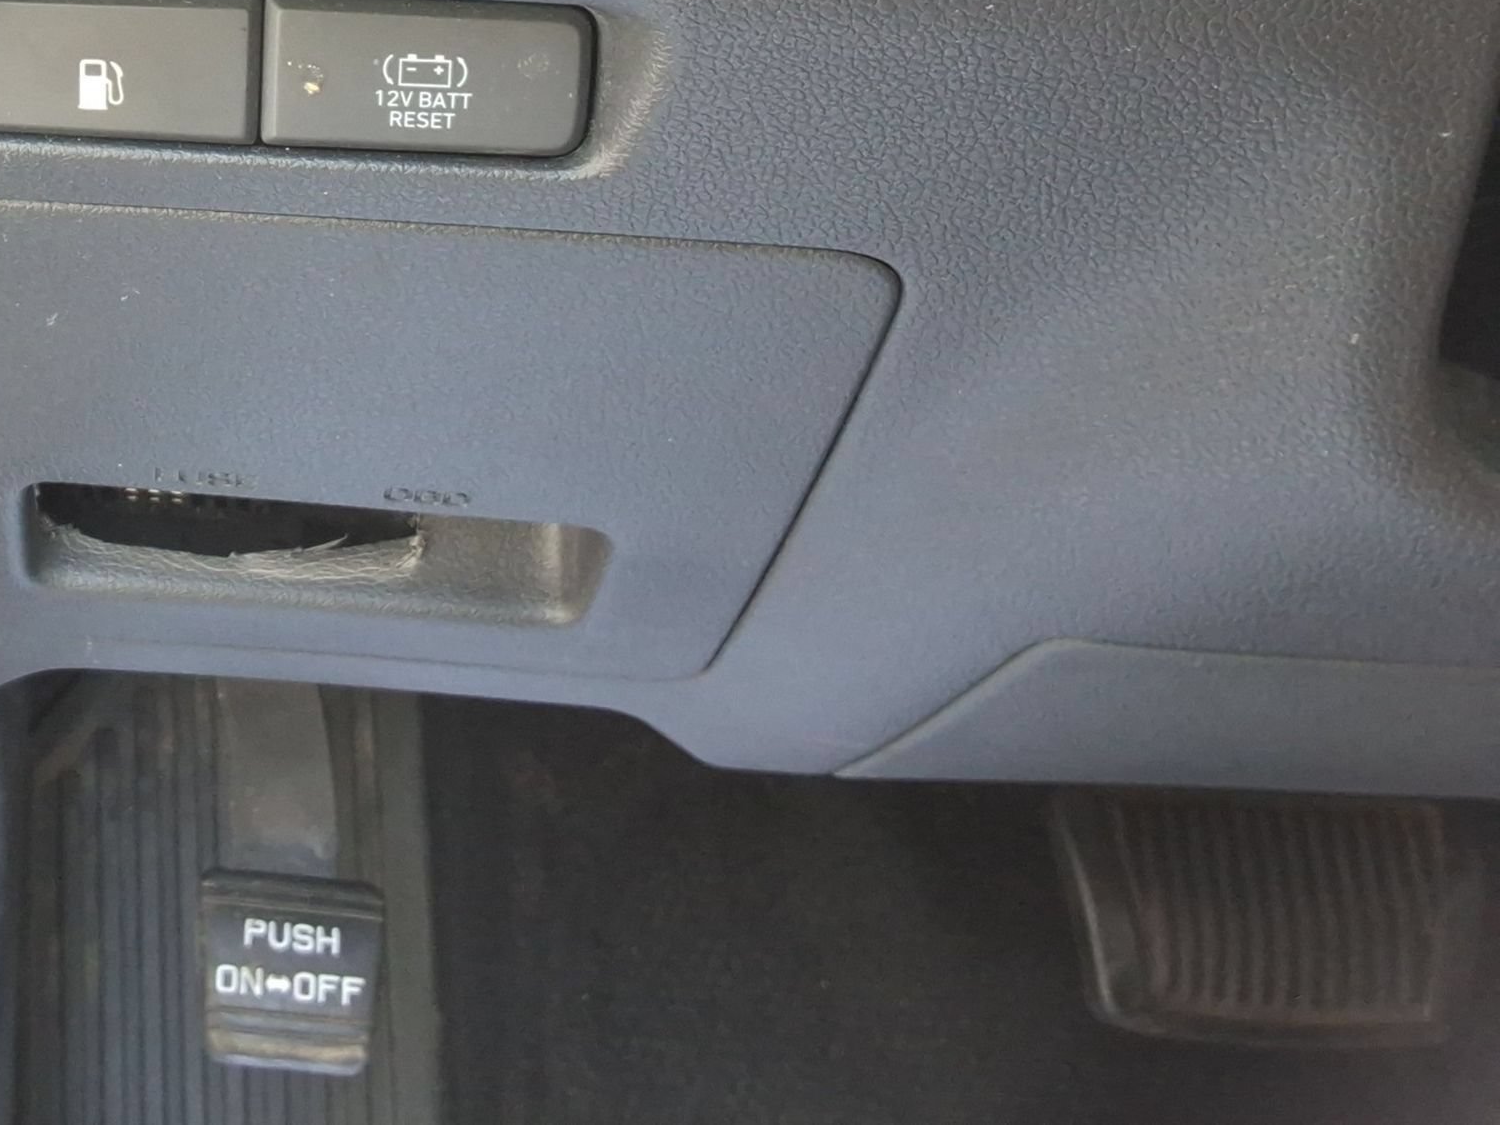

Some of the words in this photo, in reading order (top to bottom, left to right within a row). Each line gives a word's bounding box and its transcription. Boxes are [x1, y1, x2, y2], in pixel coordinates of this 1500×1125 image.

[375, 89, 414, 108] 12V
[418, 90, 474, 109] BATT
[389, 110, 456, 129] RESET
[243, 917, 342, 956] PUSH
